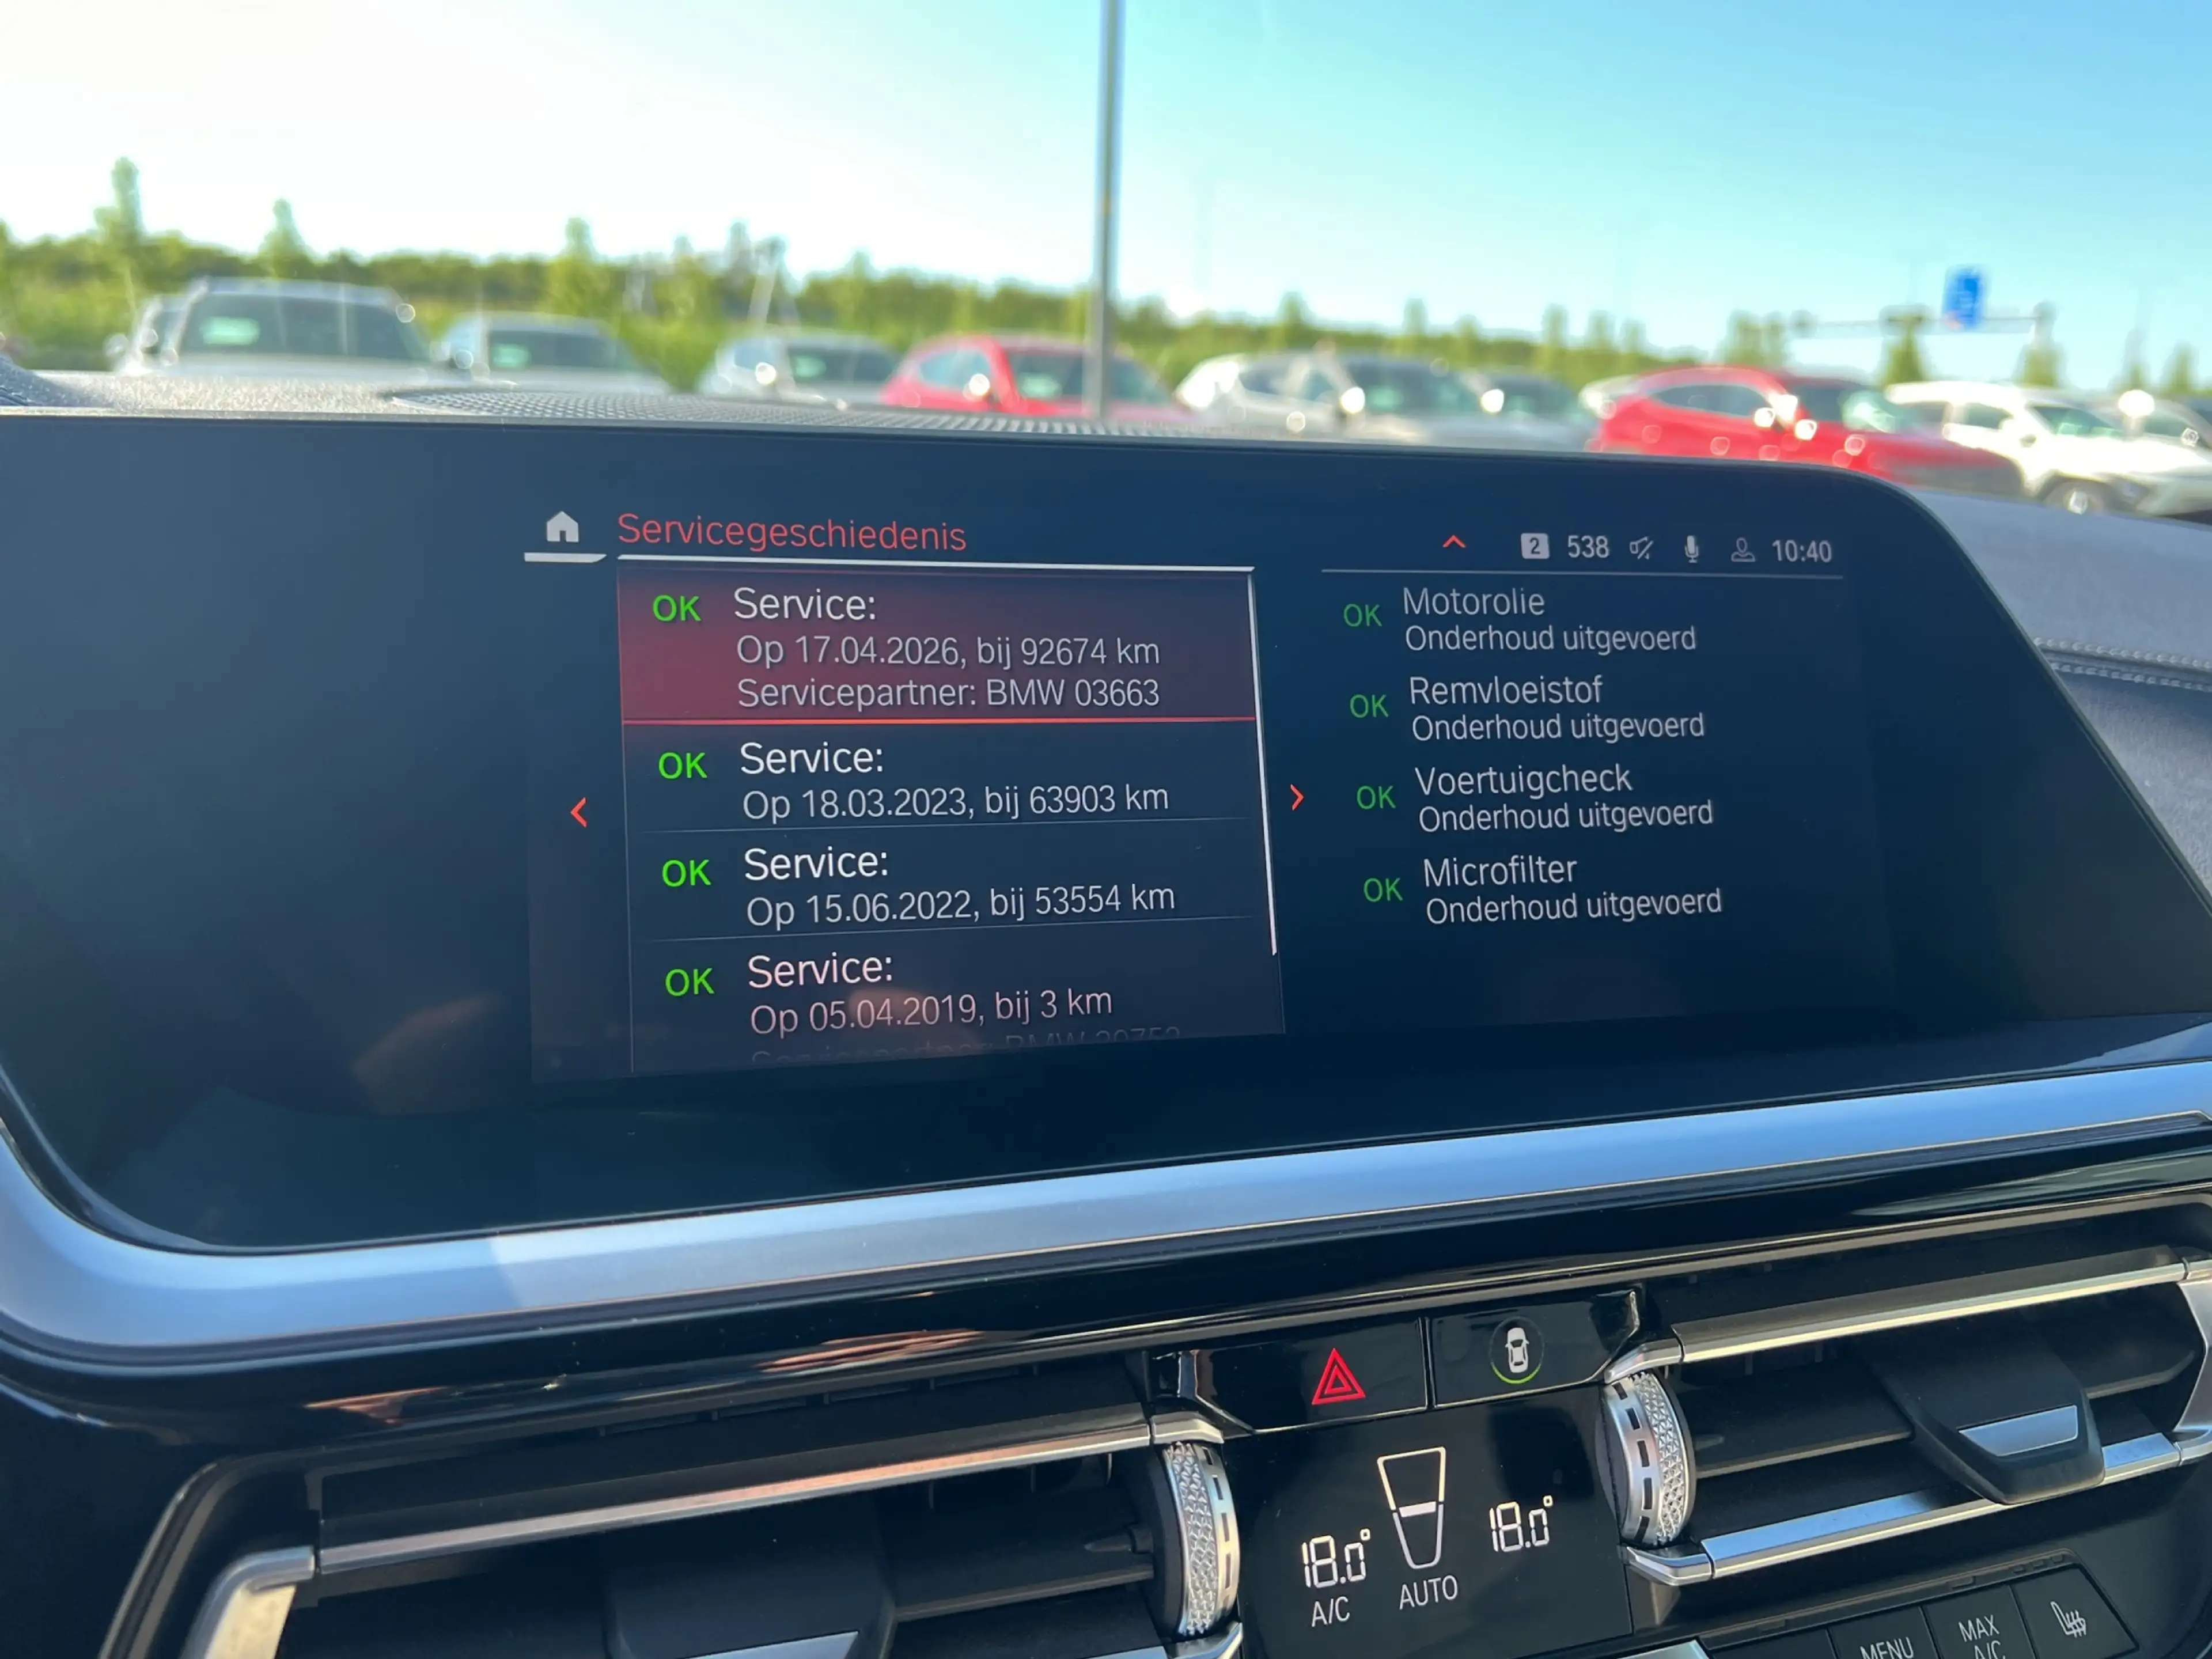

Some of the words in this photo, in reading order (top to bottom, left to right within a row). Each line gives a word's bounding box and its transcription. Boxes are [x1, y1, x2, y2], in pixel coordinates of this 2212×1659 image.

[619, 513, 966, 552] Servicegeschiedenis
[1567, 535, 1609, 558] 538
[1772, 539, 1832, 563] 10:40
[653, 594, 701, 622] OK
[734, 587, 876, 620] Service:
[1343, 604, 1382, 627] OK
[1403, 587, 1545, 615] Motorolie
[737, 635, 783, 669] Op
[795, 635, 966, 669] 17.04.2026,
[977, 637, 1011, 671] bij
[1021, 638, 1107, 666] 92674
[1116, 637, 1159, 664] km
[1406, 624, 1554, 651] Onderhoud
[1563, 624, 1696, 656] uitgevoerd
[737, 677, 976, 713] Servicepartner:
[987, 679, 1065, 706] BMW
[1075, 679, 1160, 707] 03663
[1410, 674, 1603, 705] Remvloeistof
[1350, 694, 1389, 718] OK
[1412, 713, 1562, 741] Onderhoud
[1571, 712, 1705, 744] uitgevoerd
[658, 752, 707, 779] OK
[741, 741, 883, 774] Service:
[1357, 785, 1396, 810] OK
[1414, 763, 1633, 800] Voertuigcheck
[743, 790, 790, 825] Op
[802, 787, 974, 820] 18.03.2023,
[985, 785, 1019, 820] bij
[1030, 785, 1115, 814] 63903
[1126, 783, 1168, 810] km
[1419, 802, 1569, 832] Onderhoud
[1578, 799, 1713, 832] uitgevoerd
[662, 859, 711, 887] OK
[745, 846, 888, 881] Service:
[1423, 854, 1577, 887] Microfilter
[1363, 877, 1403, 902] OK
[747, 897, 795, 931] Op
[806, 890, 979, 923] 15.06.2022,
[990, 887, 1024, 921] bij
[1036, 884, 1121, 915] 53554
[1131, 883, 1175, 910] km
[1426, 896, 1578, 925] Onderhoud
[1586, 887, 1722, 922] uitgevoerd
[665, 968, 714, 997] OK
[748, 951, 892, 988] Service:
[751, 1005, 798, 1039] Op
[809, 994, 984, 1031] 05.04.2019,
[995, 990, 1029, 1025] bij
[1040, 990, 1057, 1018] 3
[1068, 987, 1112, 1015] km
[1399, 1575, 1458, 1610] AUTO
[1311, 1596, 1350, 1627] A/C
[1958, 1614, 1999, 1642] MAX
